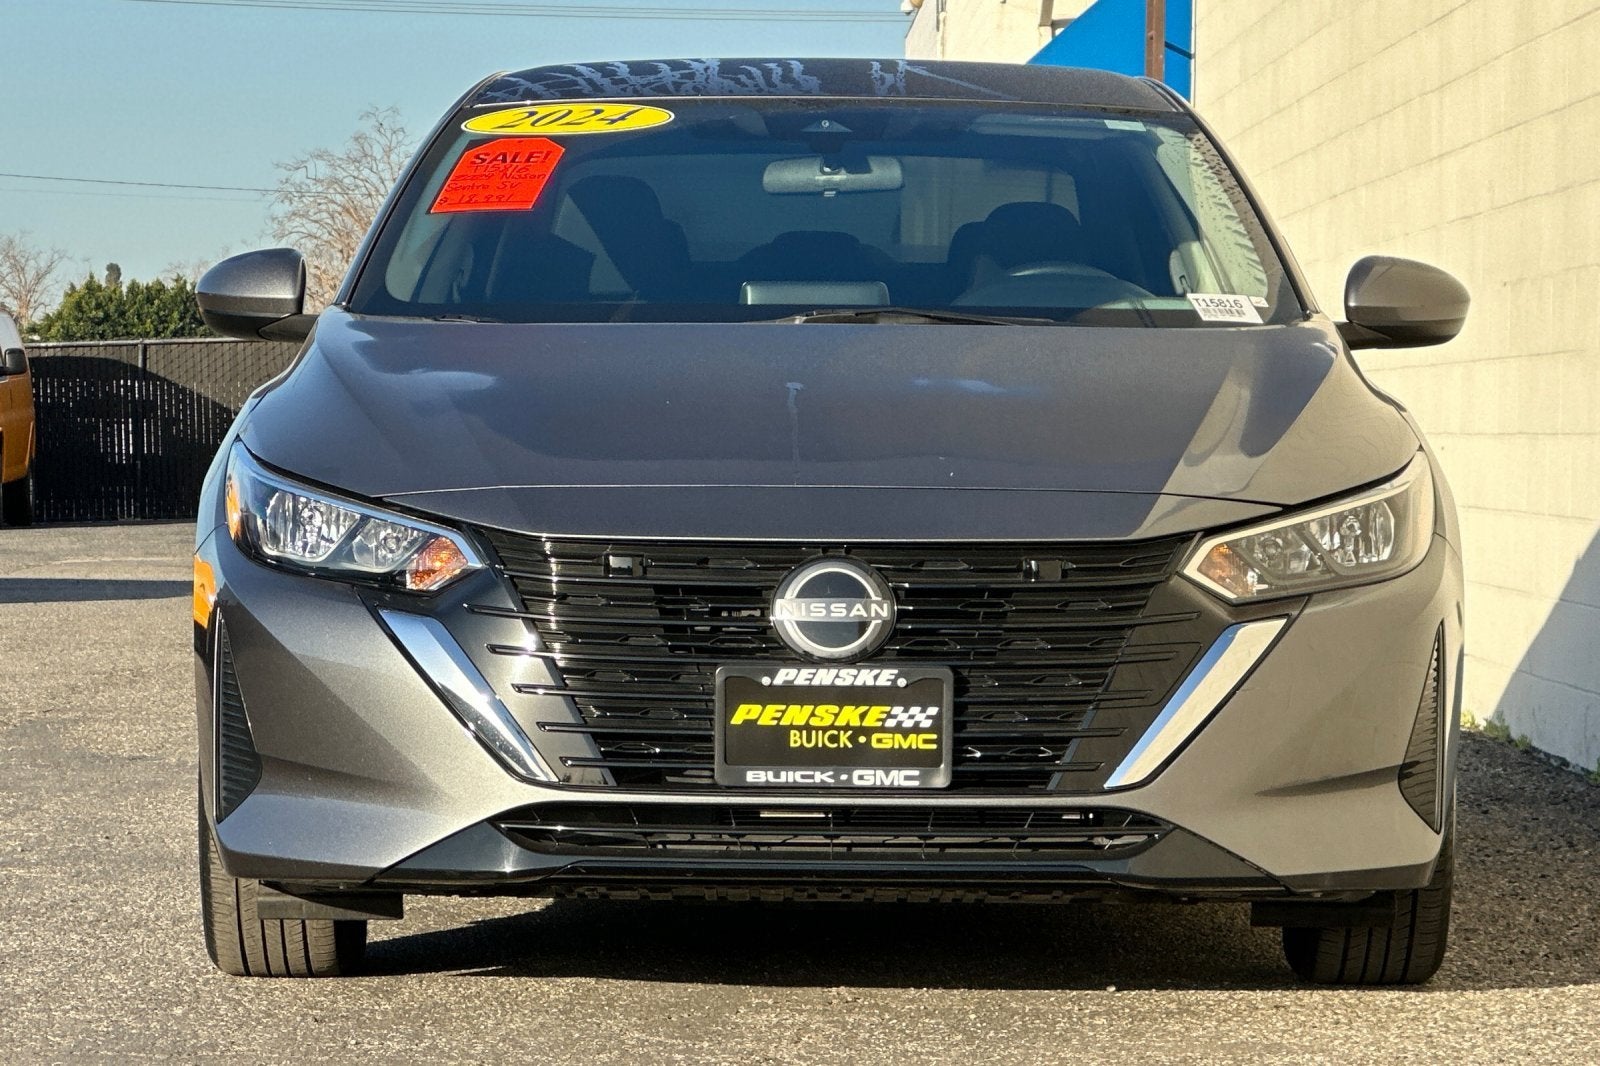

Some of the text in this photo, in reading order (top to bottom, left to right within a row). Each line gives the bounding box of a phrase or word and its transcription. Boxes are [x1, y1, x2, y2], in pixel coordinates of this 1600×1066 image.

[490, 106, 646, 130] 2024
[469, 150, 553, 165] SALE!
[1192, 298, 1243, 309] T15816
[780, 602, 888, 618] NISSAN
[771, 668, 899, 687] PENSKE
[730, 703, 892, 727] PENSKE
[789, 729, 938, 750] BUICK GMC
[745, 769, 920, 786] BUICK GMC
